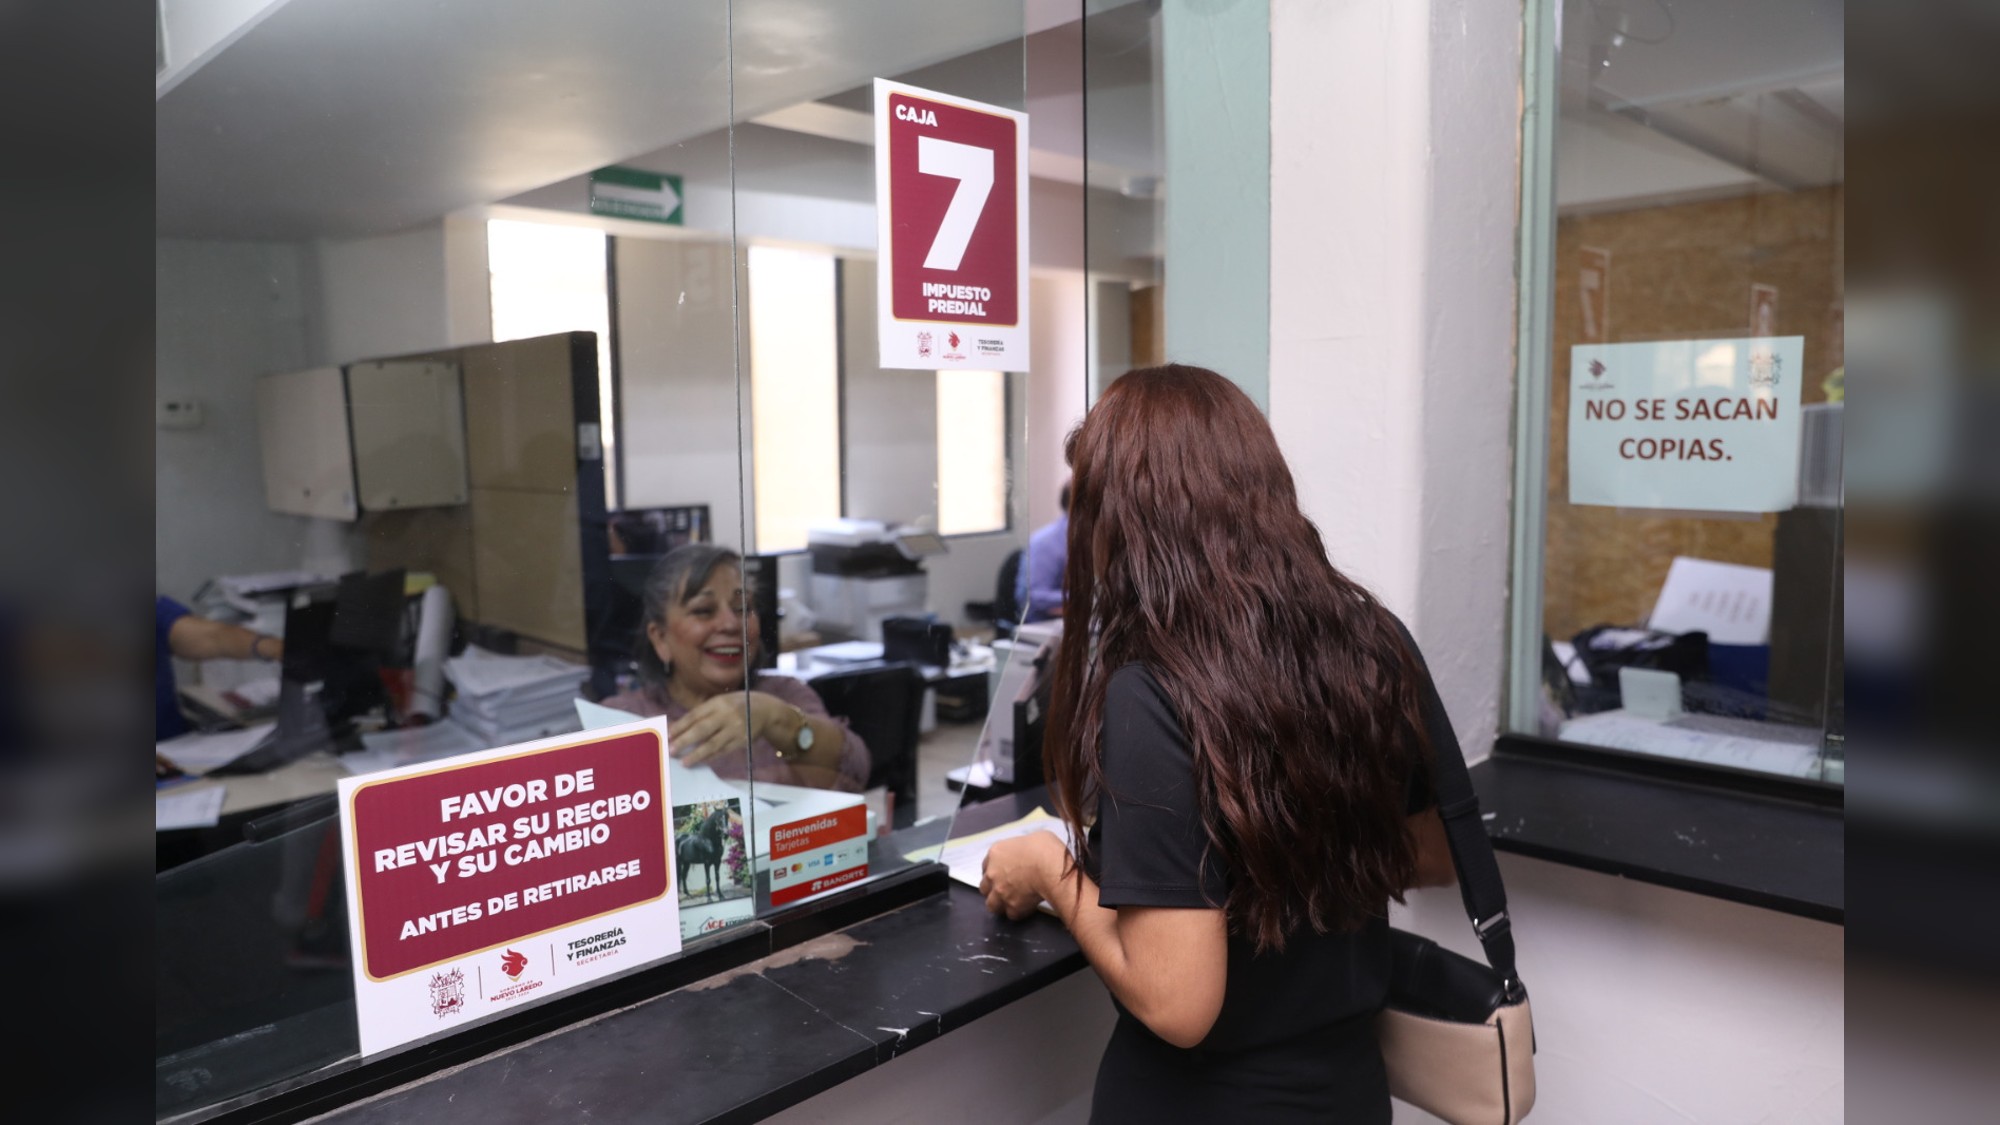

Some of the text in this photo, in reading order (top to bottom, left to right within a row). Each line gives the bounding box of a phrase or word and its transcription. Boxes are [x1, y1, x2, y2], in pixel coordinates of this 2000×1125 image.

[895, 104, 938, 127] CAJA
[918, 135, 994, 271] 7
[922, 282, 991, 302] IMPUESTO
[928, 299, 986, 316] PREDIAL
[1585, 397, 1779, 421] NO SE SACAN
[1619, 438, 1733, 462] COPIAS.
[440, 768, 594, 823] FAVOR DE
[374, 790, 651, 873] REVISAR SU RECIBO
[774, 816, 838, 842] Bienvenidas
[429, 824, 610, 885] Y SU CAMBIO
[774, 836, 810, 854] Tarjetas
[823, 869, 865, 888] BANORTE
[399, 859, 641, 941] ANTES DE RETIRARSE
[705, 919, 725, 931] ACE
[567, 926, 624, 950] TESORERÍA
[567, 937, 627, 962] Y FINANZAS
[576, 950, 620, 967] SECRETARÍA
[490, 988, 516, 1002] NUEVO
[515, 980, 543, 996] LAREDO
